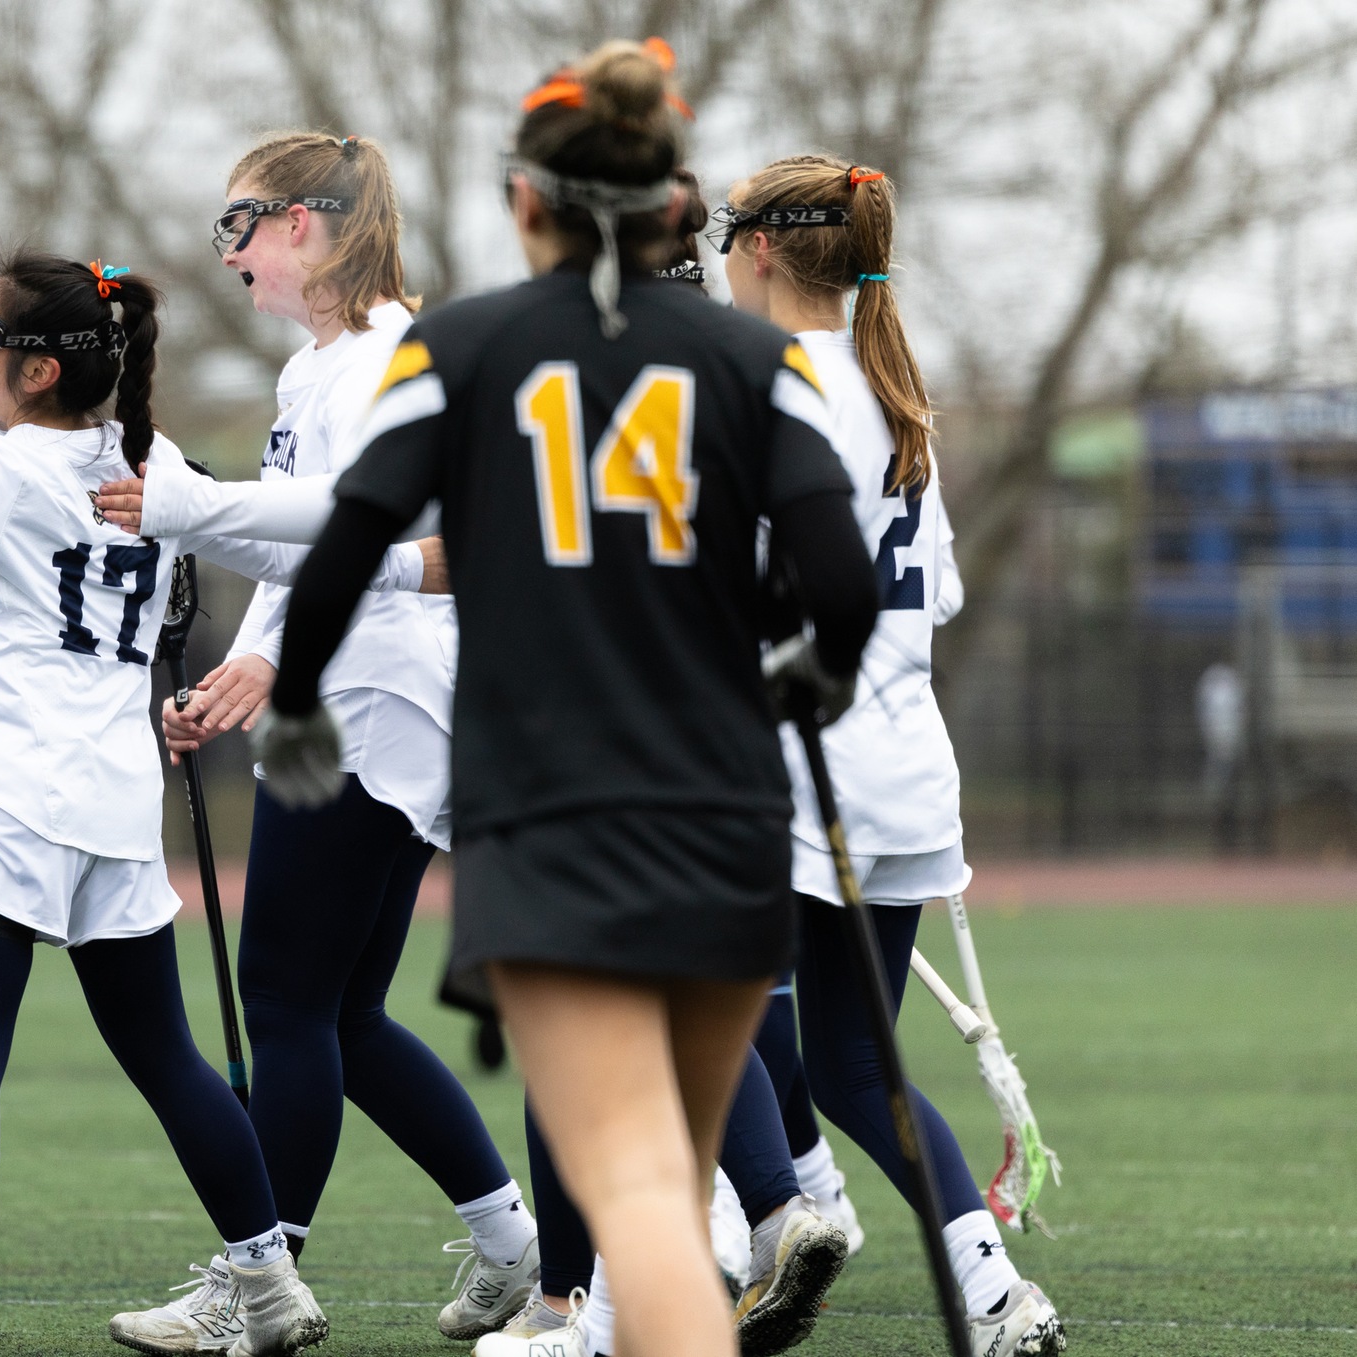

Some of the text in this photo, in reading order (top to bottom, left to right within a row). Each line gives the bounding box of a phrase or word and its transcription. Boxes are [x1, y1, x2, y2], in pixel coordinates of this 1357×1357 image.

[254, 197, 342, 215] STX STX
[786, 210, 827, 223] STX
[6, 335, 47, 347] STX
[60, 328, 99, 345] STX
[515, 361, 700, 568] 14
[52, 541, 161, 667] 17
